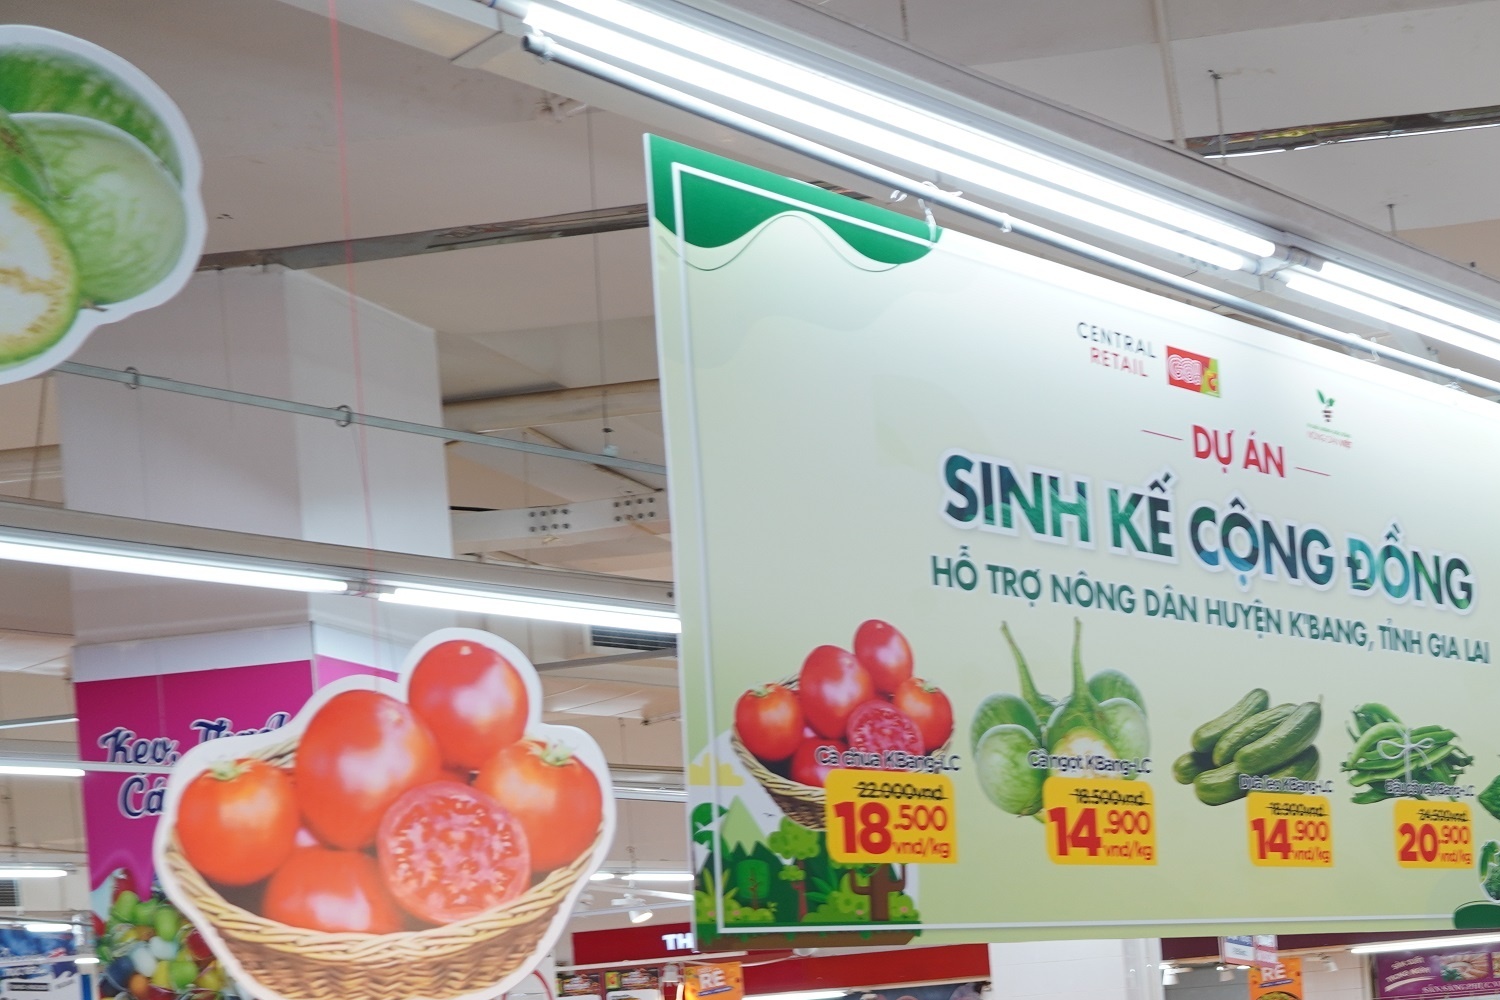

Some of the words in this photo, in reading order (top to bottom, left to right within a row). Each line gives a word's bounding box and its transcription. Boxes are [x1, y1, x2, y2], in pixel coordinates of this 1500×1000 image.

[1077, 322, 1156, 358] CENTRAL
[1091, 347, 1148, 377] RETAIL
[1192, 424, 1236, 474] DỰ
[1242, 431, 1286, 478] ÁN
[944, 453, 1092, 543] SINH
[1108, 471, 1174, 558] KẾ
[1190, 497, 1335, 587] CỘNG
[1346, 522, 1473, 610] ĐỒNG
[931, 544, 978, 592] HỖ
[986, 563, 1042, 608] TRỢ
[1051, 570, 1137, 614] NÔNG
[1144, 584, 1200, 624] DÂN
[1205, 599, 1283, 640] HUYỆN
[1378, 617, 1424, 656] TỈNH
[1427, 632, 1461, 660] GIA
[1465, 638, 1491, 665] LAI
[892, 838, 951, 859] vnd/kg
[1104, 841, 1153, 861] vnd/kg
